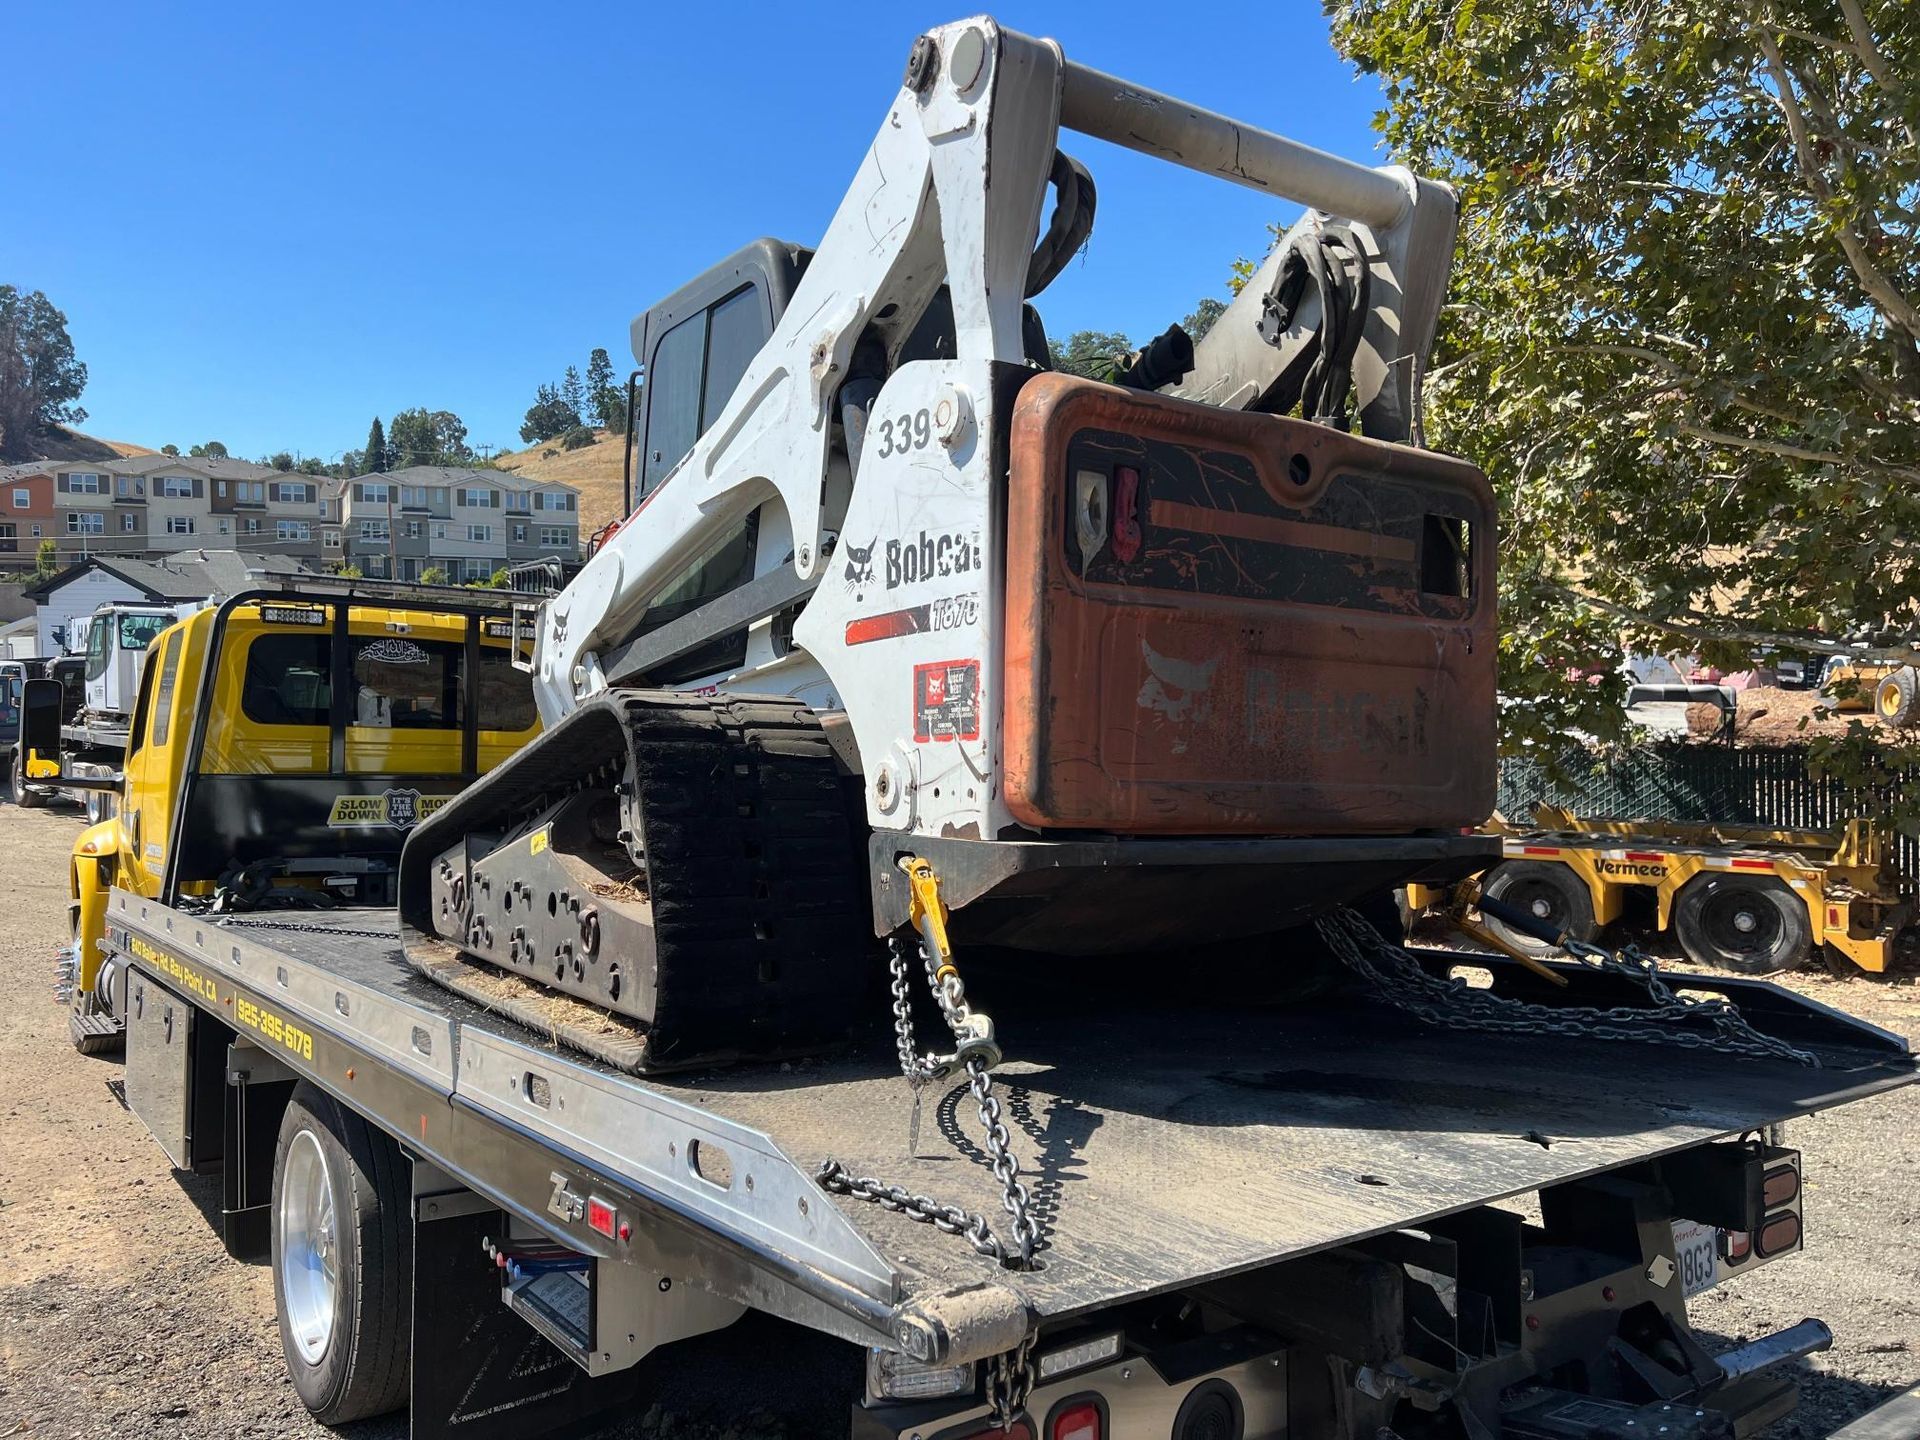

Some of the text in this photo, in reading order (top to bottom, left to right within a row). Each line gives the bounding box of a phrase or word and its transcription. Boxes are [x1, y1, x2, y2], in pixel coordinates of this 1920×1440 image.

[878, 408, 931, 459] 339
[886, 530, 981, 590] Bobcat
[337, 810, 381, 820] DOWN
[340, 800, 381, 810] SLOW
[391, 803, 411, 811] THE
[1593, 858, 1669, 877] Vermeer
[169, 957, 184, 985] Bay
[206, 979, 217, 1003] CA
[238, 998, 313, 1061] 925-395-6178
